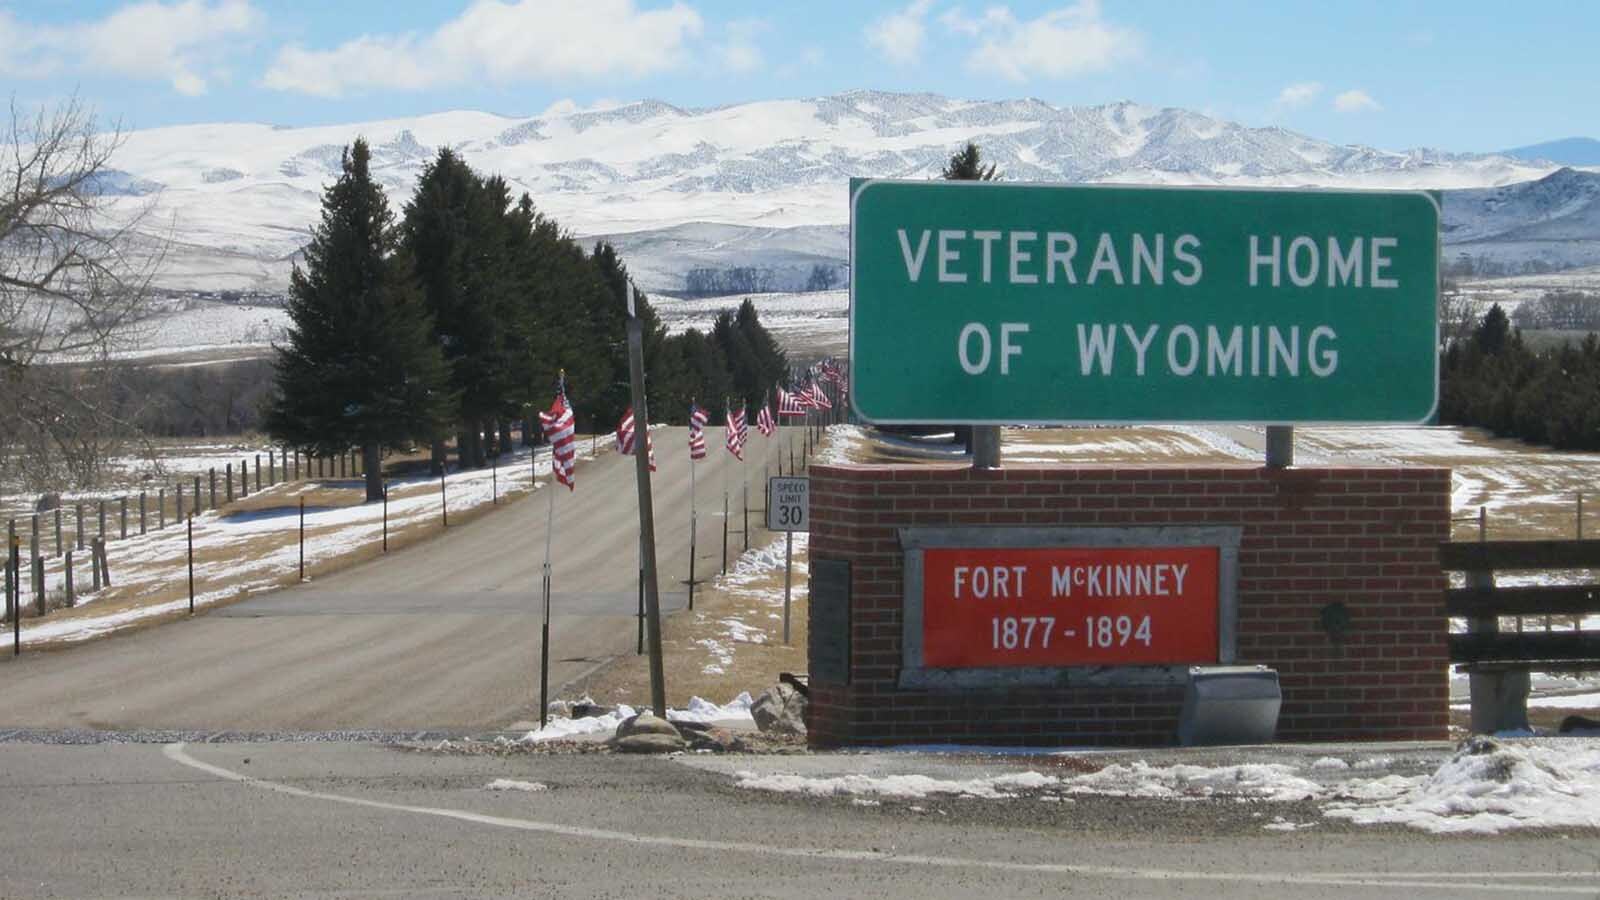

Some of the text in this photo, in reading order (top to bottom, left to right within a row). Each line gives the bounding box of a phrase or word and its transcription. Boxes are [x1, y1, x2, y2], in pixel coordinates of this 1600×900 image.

[898, 229, 1398, 288] VETERANS HOME
[958, 323, 1338, 377] OF WYOMING
[777, 482, 805, 493] SPEED
[779, 495, 801, 504] LIMIT
[779, 505, 802, 525] 30
[954, 566, 1027, 598] FORT
